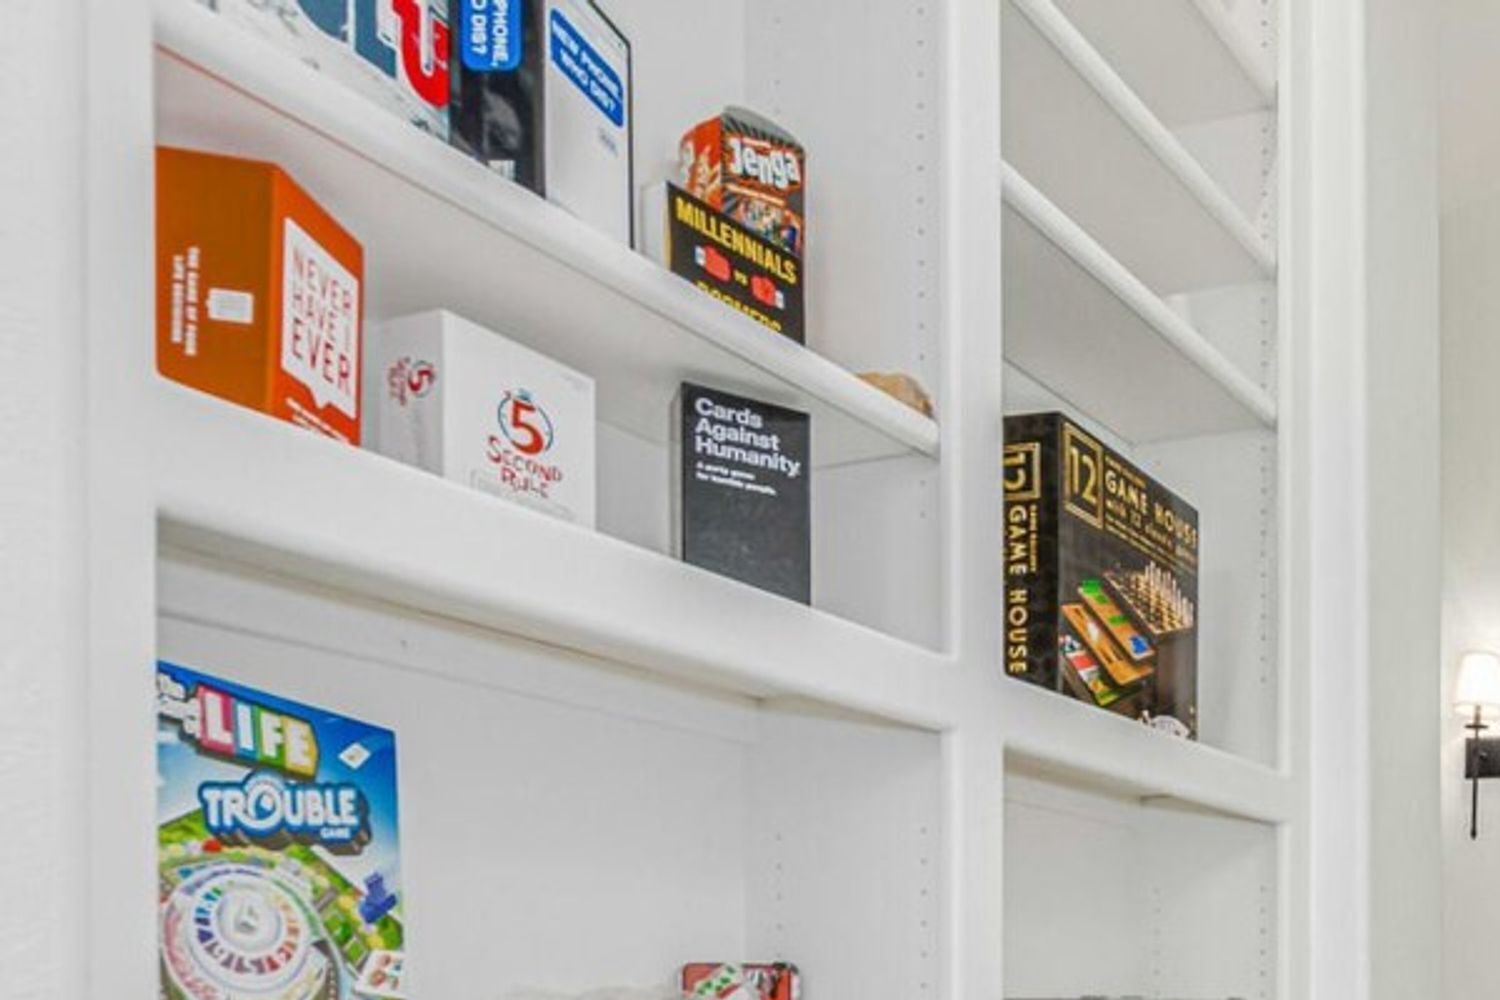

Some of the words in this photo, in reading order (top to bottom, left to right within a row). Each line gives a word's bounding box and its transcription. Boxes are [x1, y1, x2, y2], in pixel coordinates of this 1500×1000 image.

[728, 138, 801, 189] Jenga
[675, 196, 797, 284] MILLENNIALS
[292, 316, 351, 395] EVER
[511, 399, 544, 455] 5
[695, 417, 780, 451] Against
[696, 397, 762, 429] Cards
[695, 434, 801, 478] Humanity
[1070, 446, 1098, 505] 12
[1104, 469, 1148, 514] GAME
[1008, 504, 1027, 575] GAME
[1008, 589, 1028, 673] HOUSE
[204, 689, 312, 769] LIFE
[201, 777, 361, 830] TROUBLE
